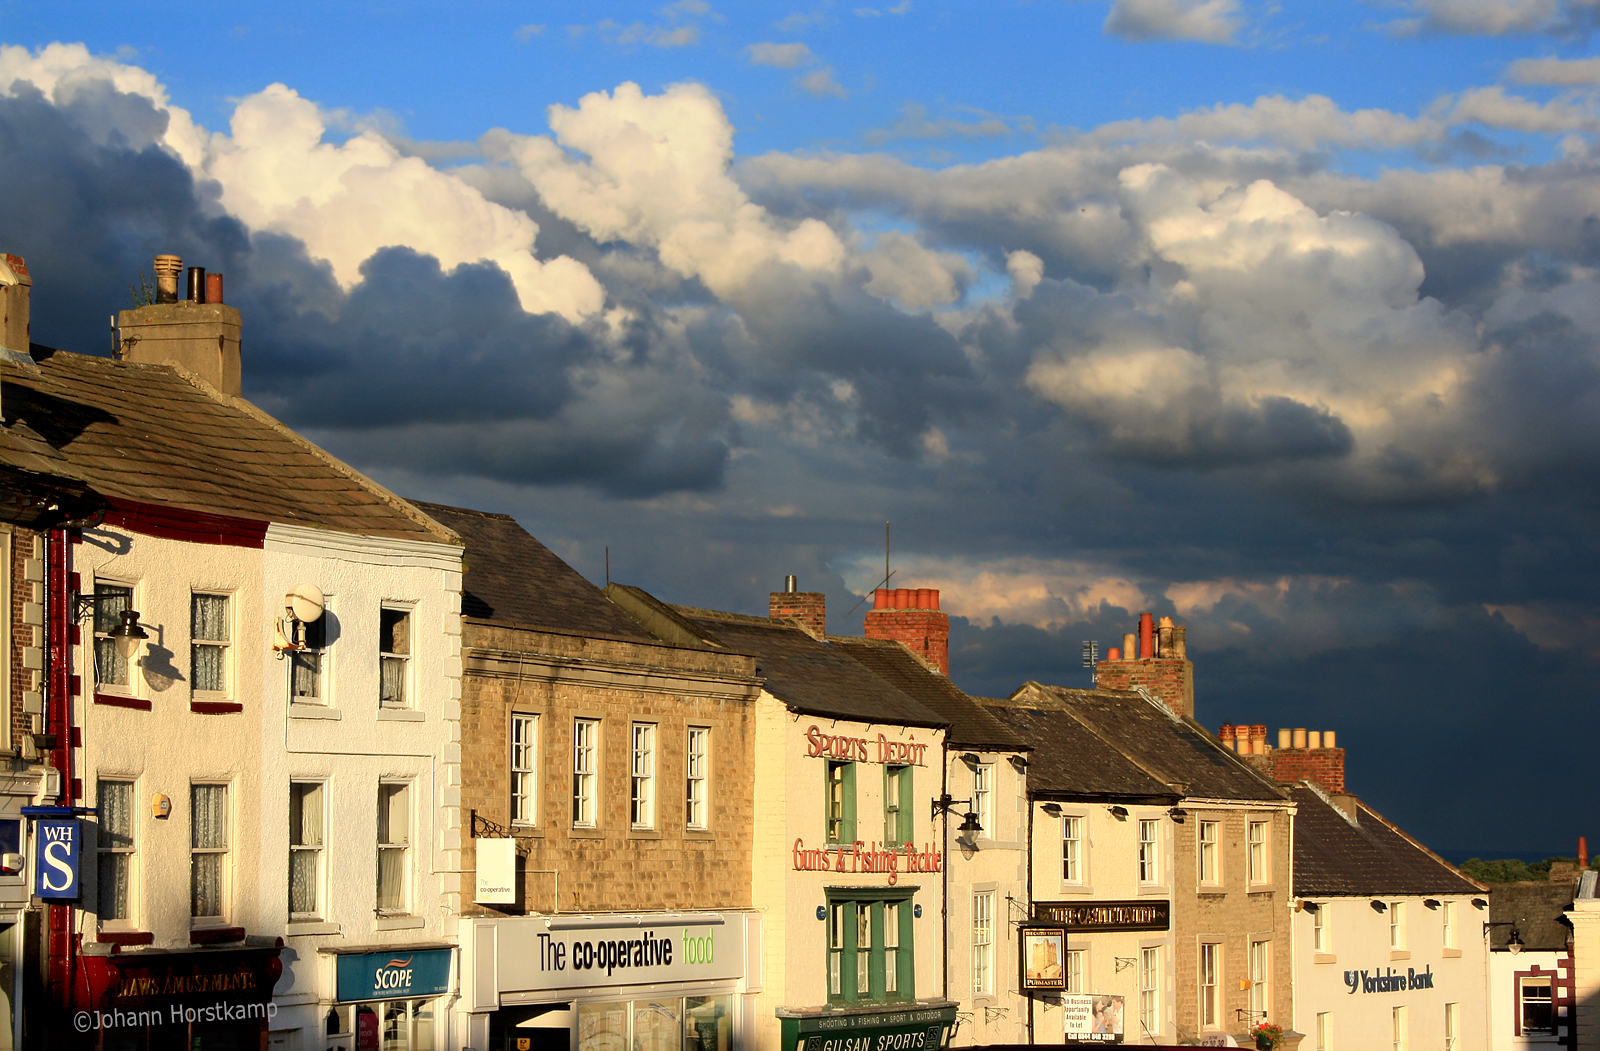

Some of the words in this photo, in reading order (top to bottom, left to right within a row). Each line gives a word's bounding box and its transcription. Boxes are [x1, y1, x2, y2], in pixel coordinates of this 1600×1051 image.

[807, 725, 868, 762] SPORTS
[44, 826, 73, 842] WH
[43, 841, 74, 891] S
[793, 837, 831, 871] Guns
[835, 848, 846, 872] &
[852, 839, 898, 885] Fishing
[905, 840, 942, 872] Tackle
[1077, 907, 1114, 925] CASTLE
[537, 933, 566, 971] The
[573, 931, 672, 976] co-operative
[682, 928, 714, 965] food
[114, 977, 160, 997] HAWS
[163, 972, 256, 995] AMUSEMENTS
[374, 968, 413, 989] SCOPE
[1360, 967, 1406, 993] Yorkshire
[1408, 964, 1434, 990] Bank
[819, 1018, 847, 1028] SHOOTING
[851, 1017, 855, 1026] &
[858, 1014, 880, 1024] FISHING
[890, 1011, 906, 1023] SPORT
[917, 1008, 942, 1019] OUTDOOR
[823, 1036, 871, 1051] GILSAN
[877, 1031, 925, 1051] SPORTS
